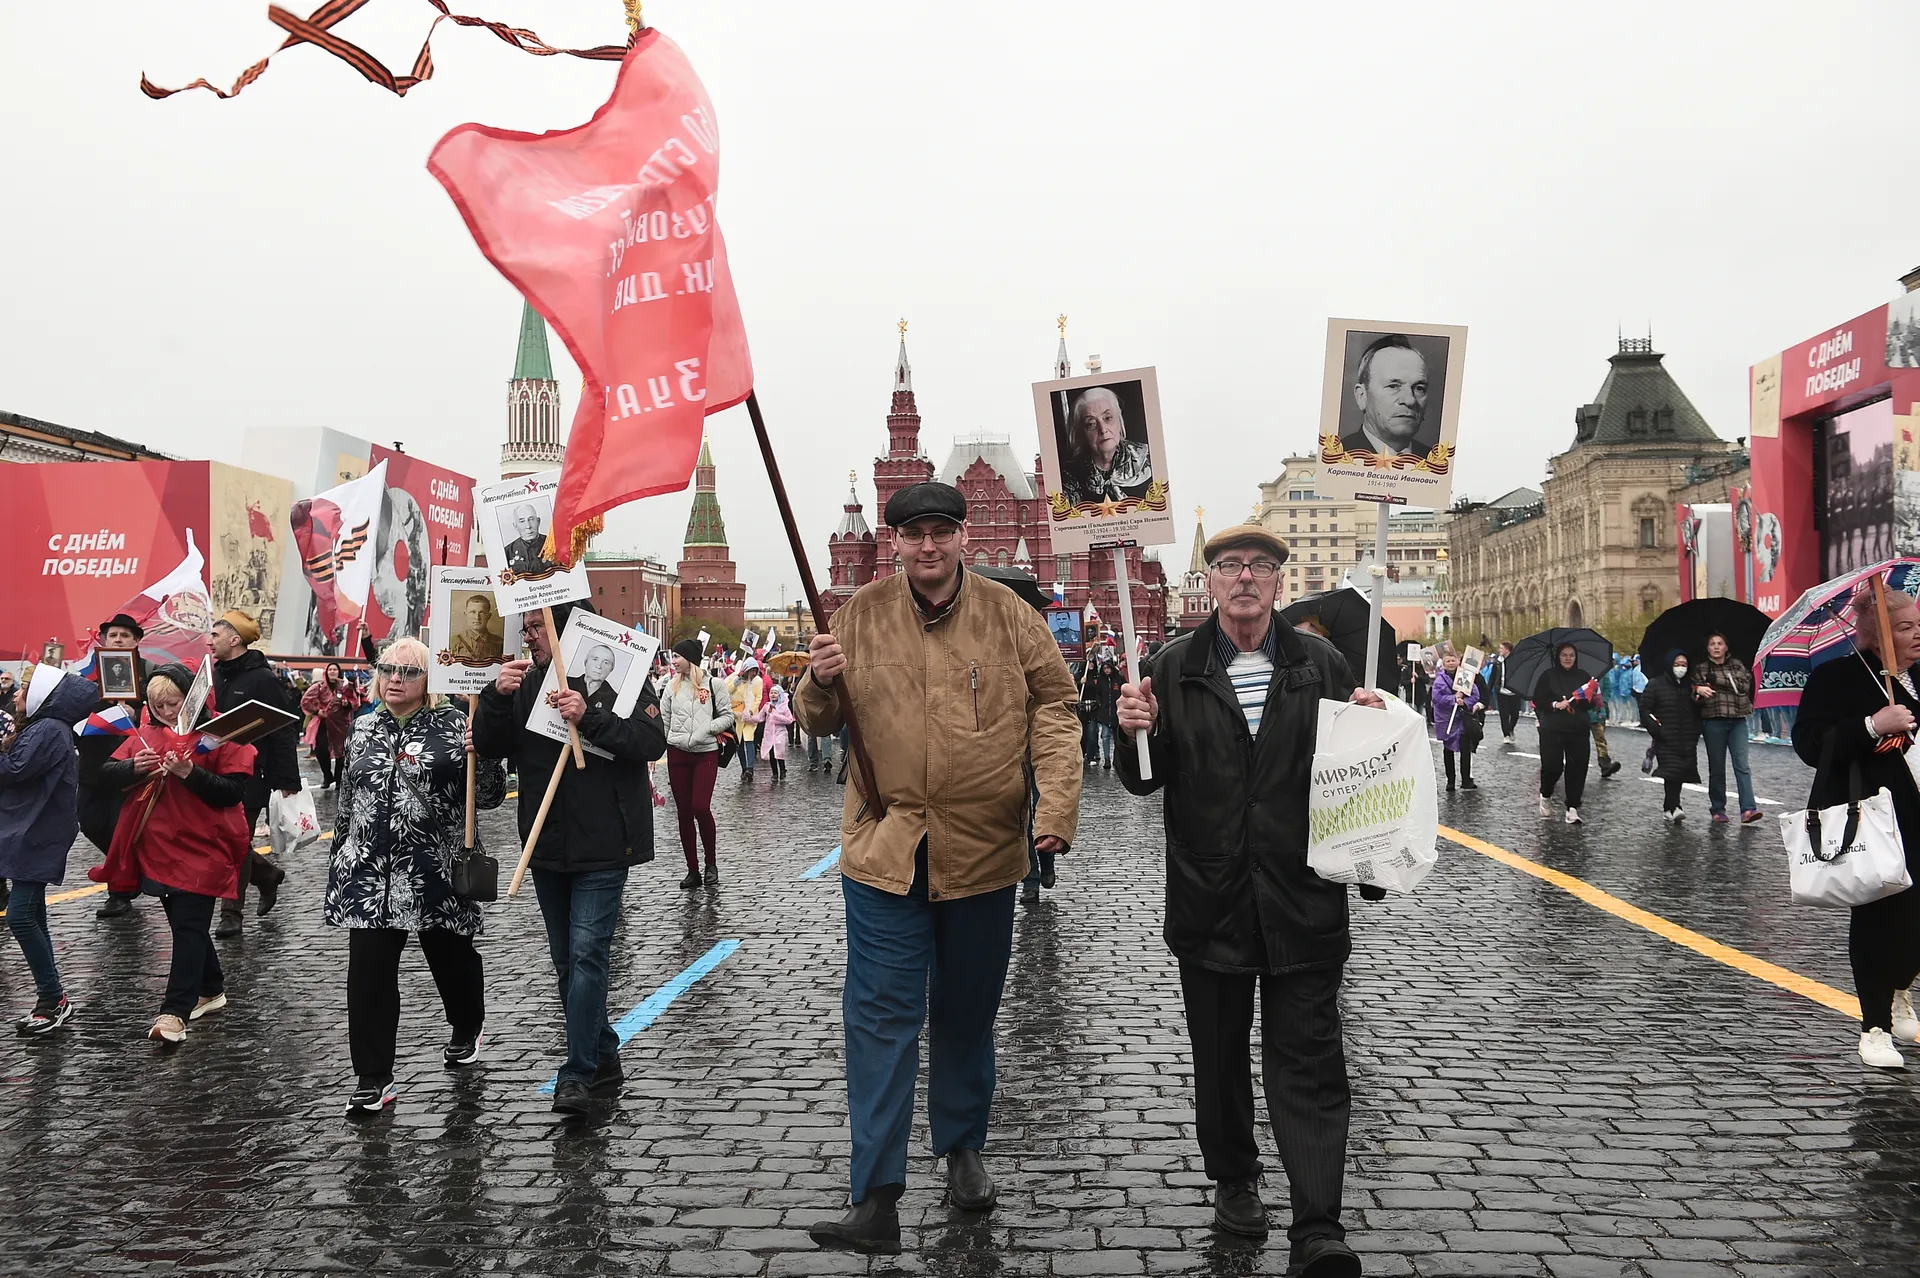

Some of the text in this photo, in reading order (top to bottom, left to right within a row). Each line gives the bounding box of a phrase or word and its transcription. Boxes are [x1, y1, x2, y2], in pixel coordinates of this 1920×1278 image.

[1808, 330, 1853, 369] С ДНЁМ
[1805, 357, 1861, 397] ПОБЕДЫ!
[1327, 467, 1439, 485] Коротков Василий Иванович
[1367, 480, 1397, 488] 1914-1980
[430, 479, 459, 502] С ДНЁМ
[428, 504, 464, 529] ПОБЕДЫ!
[48, 529, 125, 554] С ДНЁМ
[436, 539, 461, 554] 19-2022
[42, 557, 139, 578] ПОБЕДЫ!
[1758, 595, 1780, 612] МАЯ
[409, 744, 418, 752] Z
[1835, 842, 1866, 855] Bnchi
